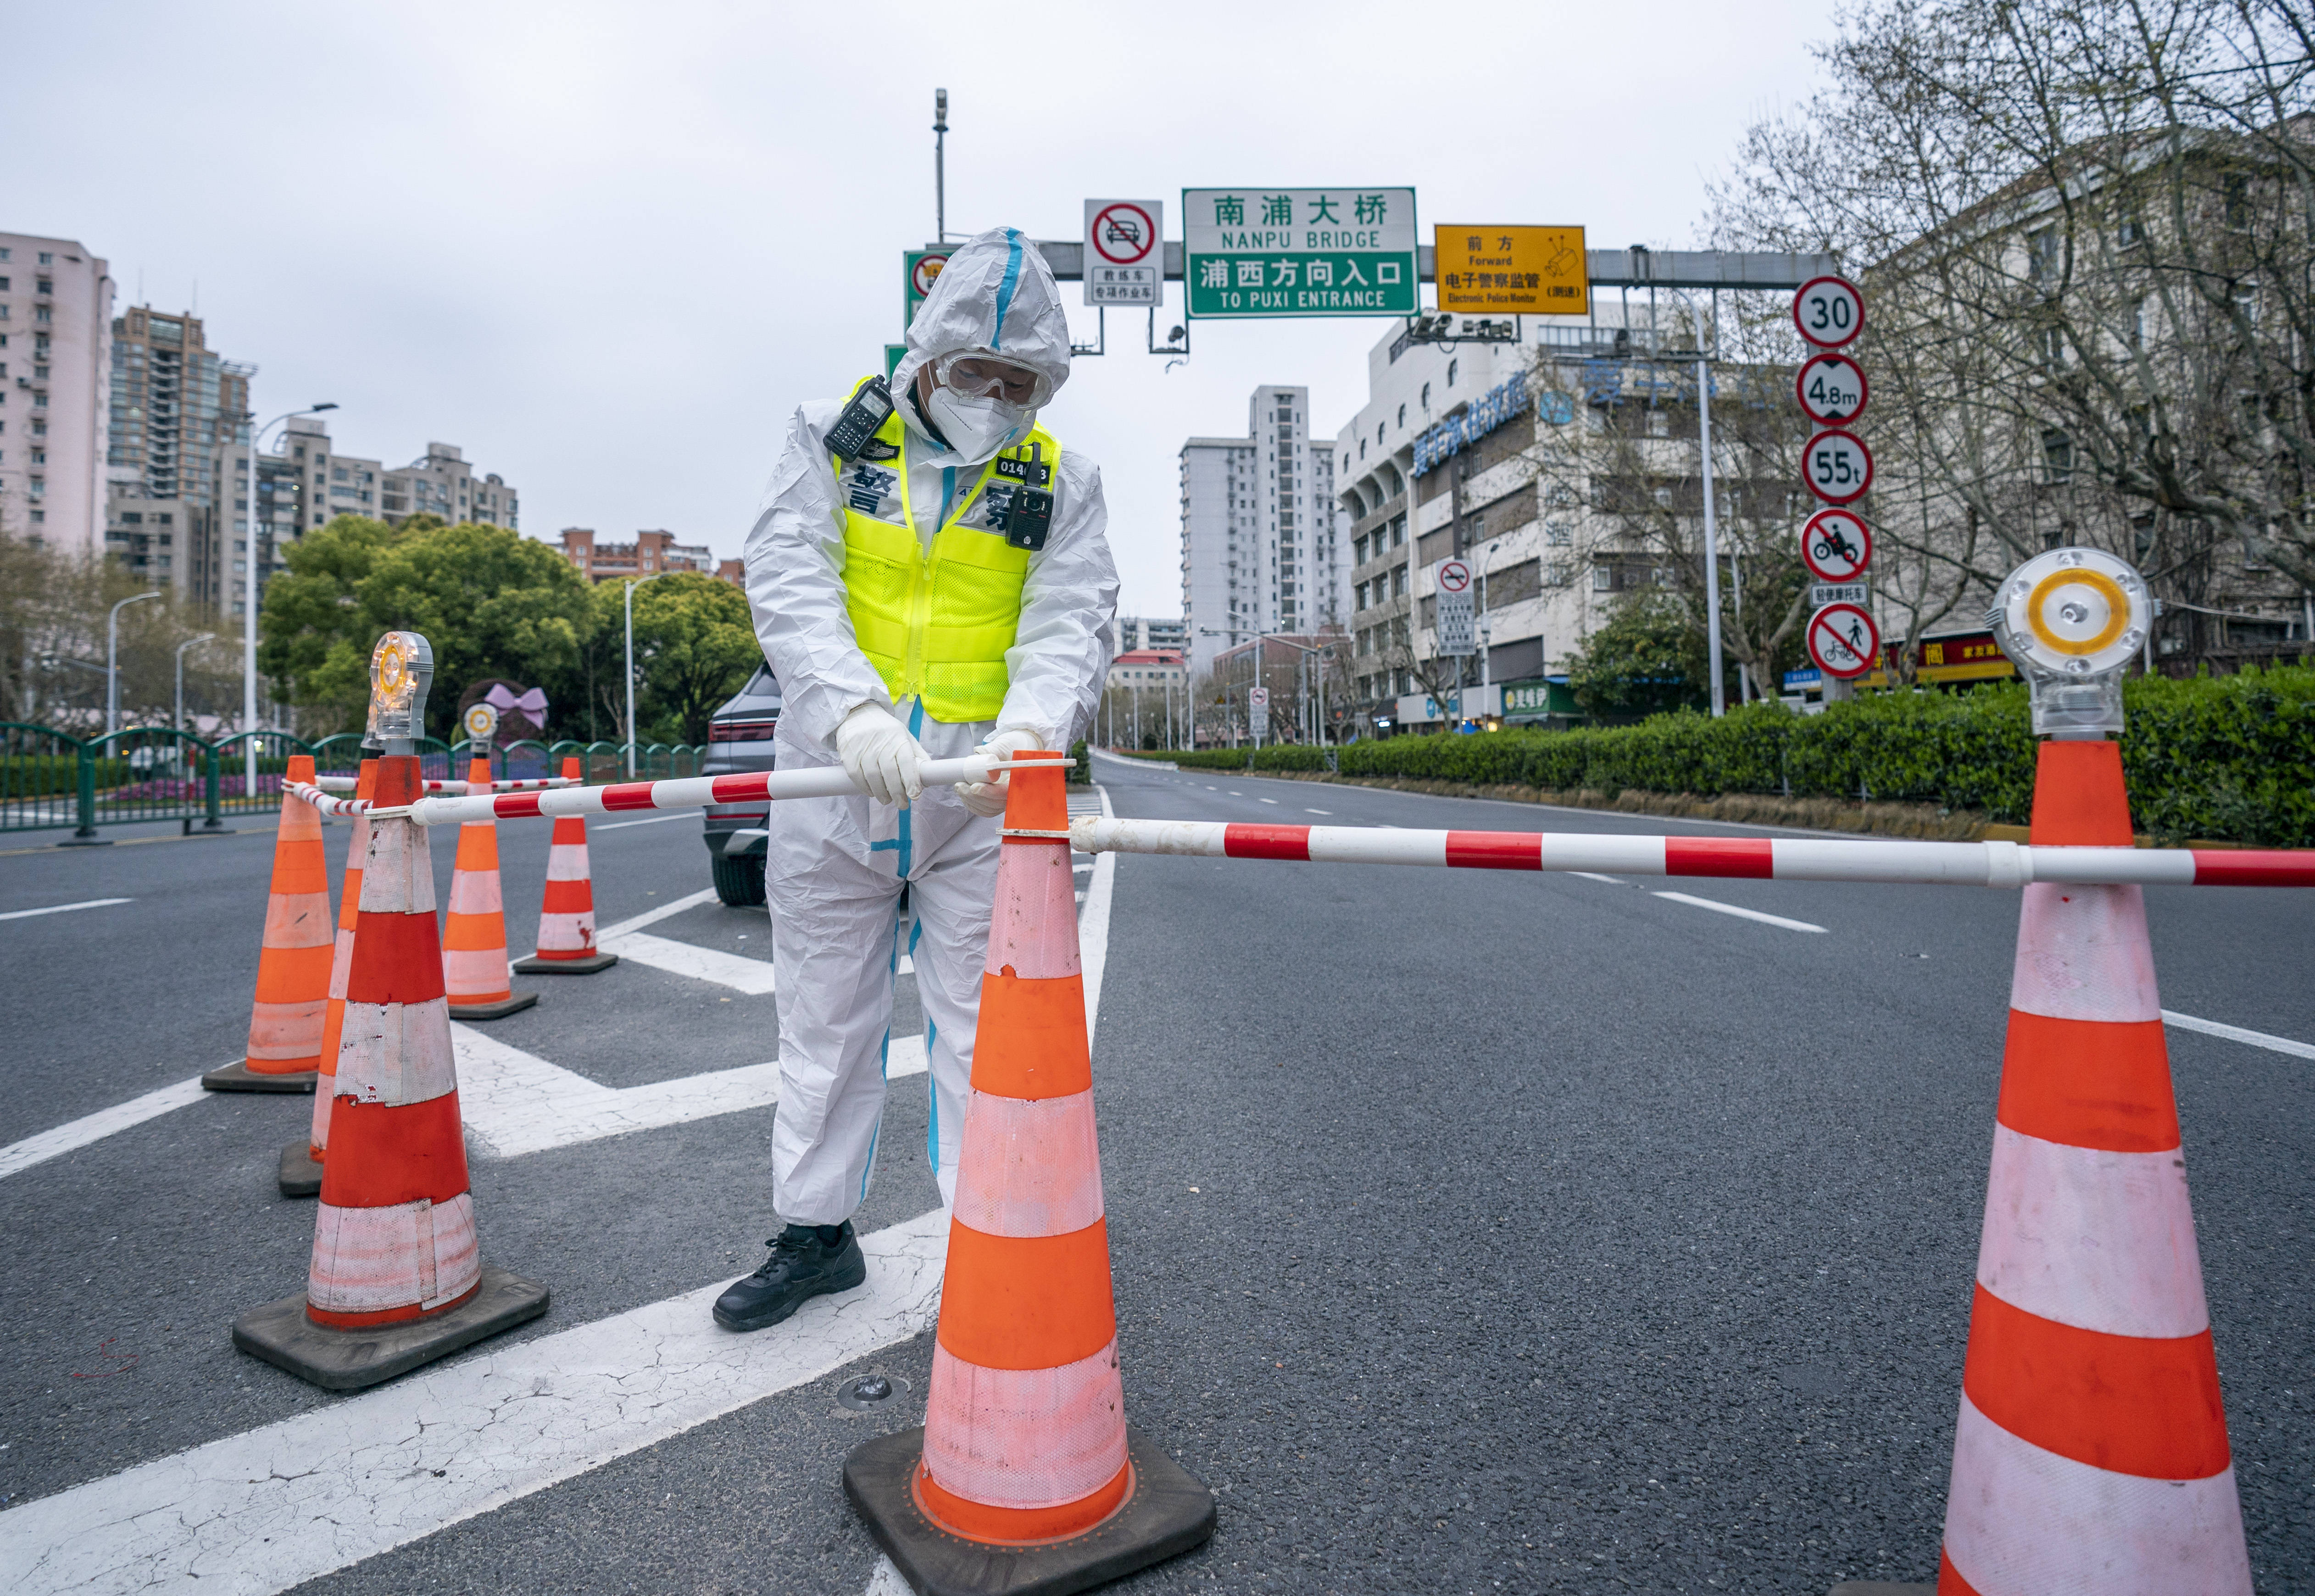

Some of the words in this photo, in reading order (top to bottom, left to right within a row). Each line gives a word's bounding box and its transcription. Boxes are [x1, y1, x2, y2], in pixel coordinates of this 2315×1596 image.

[1214, 195, 1387, 226] 南浦大桥
[1222, 231, 1291, 249] NANPU
[1307, 230, 1380, 249] BRIDGE
[1467, 235, 1513, 251] 前方
[1469, 256, 1512, 266] Forward
[1103, 270, 1144, 281] 教练车
[1200, 258, 1401, 289] 浦西方向入口
[1445, 272, 1540, 289] 电子警察监管
[1220, 292, 1241, 308] TO
[1250, 292, 1289, 308] PUXI
[1298, 291, 1385, 307] ENTRANCE
[1448, 293, 1483, 303] Electronic
[1487, 293, 1508, 303] Police
[1510, 293, 1536, 303] Monitor
[1811, 296, 1850, 329] 30
[1809, 376, 1858, 405] 4.8m
[1816, 451, 1861, 484] 55t
[847, 465, 896, 514] 警
